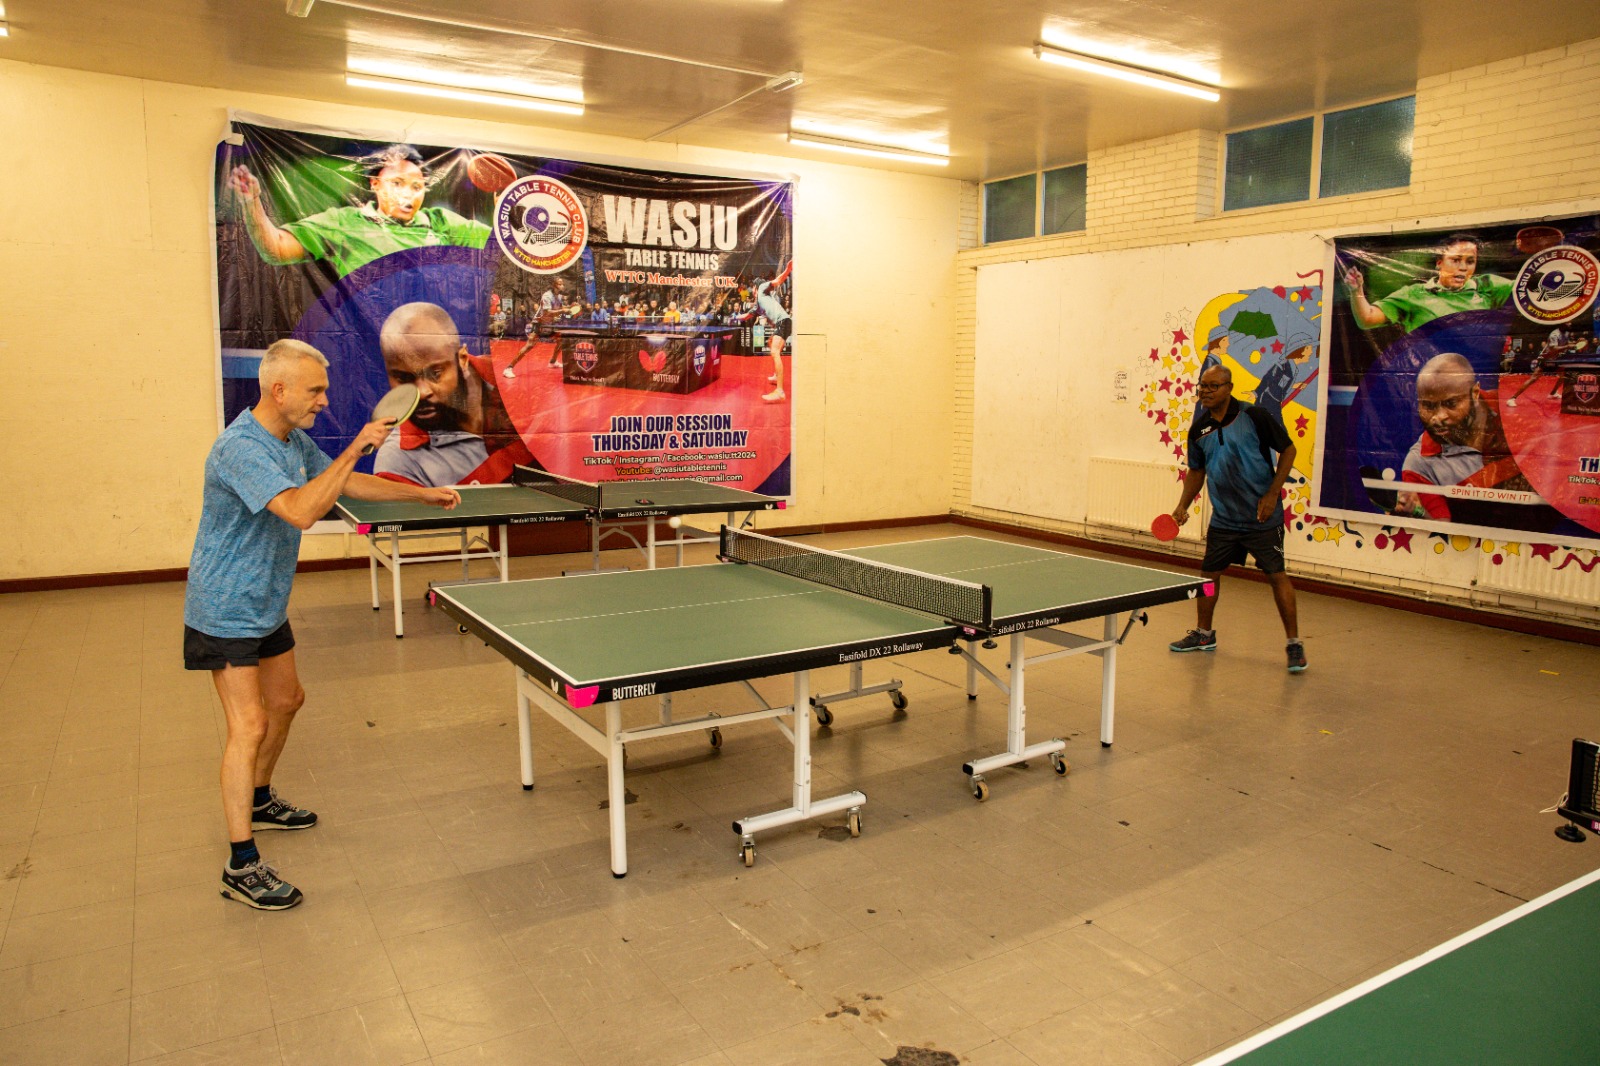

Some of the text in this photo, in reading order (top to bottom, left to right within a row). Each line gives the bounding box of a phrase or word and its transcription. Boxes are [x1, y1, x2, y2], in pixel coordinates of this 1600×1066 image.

[501, 182, 582, 244] WASIU TABLE TENNIS CLUB
[602, 194, 738, 250] WASIU
[531, 250, 572, 266] MANCHESTER
[624, 248, 719, 270] TABLE TENNIS
[605, 270, 738, 288] WTTC Manchester UK.
[1518, 250, 1596, 300] WASIU TABLE TENNIS CLUB
[610, 414, 732, 433] JOIN OUR SESSION
[592, 430, 748, 452] THURSDAY & SATURDAY
[584, 457, 612, 465] TikTok
[620, 456, 660, 464] Instagram
[668, 452, 706, 462] Facebook:
[708, 451, 756, 460] wasiu.tt2024
[654, 462, 726, 474] @wasiutabletennis
[1568, 476, 1596, 484] TikTok
[1482, 490, 1495, 498] TO
[1498, 492, 1516, 500] WIN
[378, 524, 402, 532] BUTTERFLY
[1016, 622, 1026, 632] DX
[1035, 617, 1060, 627] Rollaway
[839, 642, 924, 662] Easifold DX 22 Rollaway
[612, 682, 656, 700] BUTTERFLY
